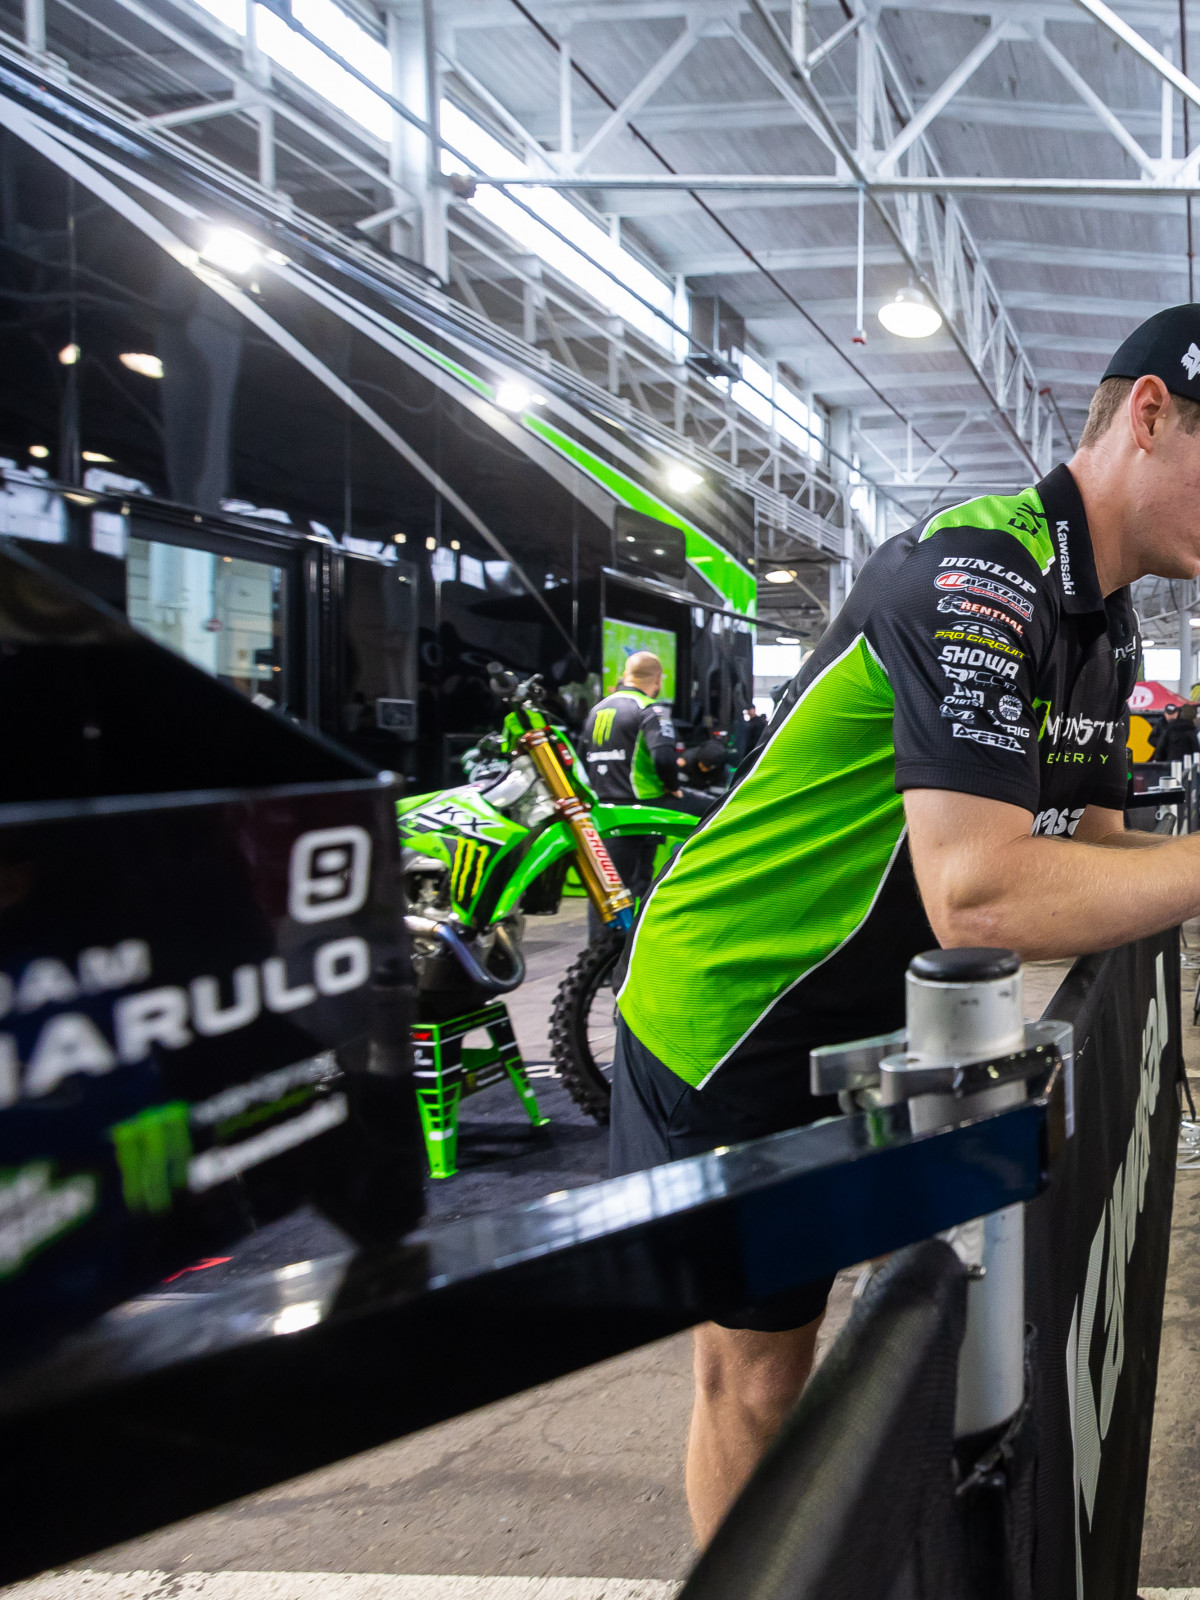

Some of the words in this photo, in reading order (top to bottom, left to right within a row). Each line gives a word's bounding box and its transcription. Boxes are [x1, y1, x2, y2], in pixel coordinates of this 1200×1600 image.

[938, 557, 1037, 594] DUNLOP
[1055, 520, 1076, 596] Kawasaki
[960, 601, 1024, 636] RENTHAL
[934, 631, 966, 641] PRO
[966, 633, 1025, 659] CIRCUIT
[938, 645, 1020, 680] SHOWA
[424, 806, 493, 833] KX
[585, 830, 621, 882] SHOWA
